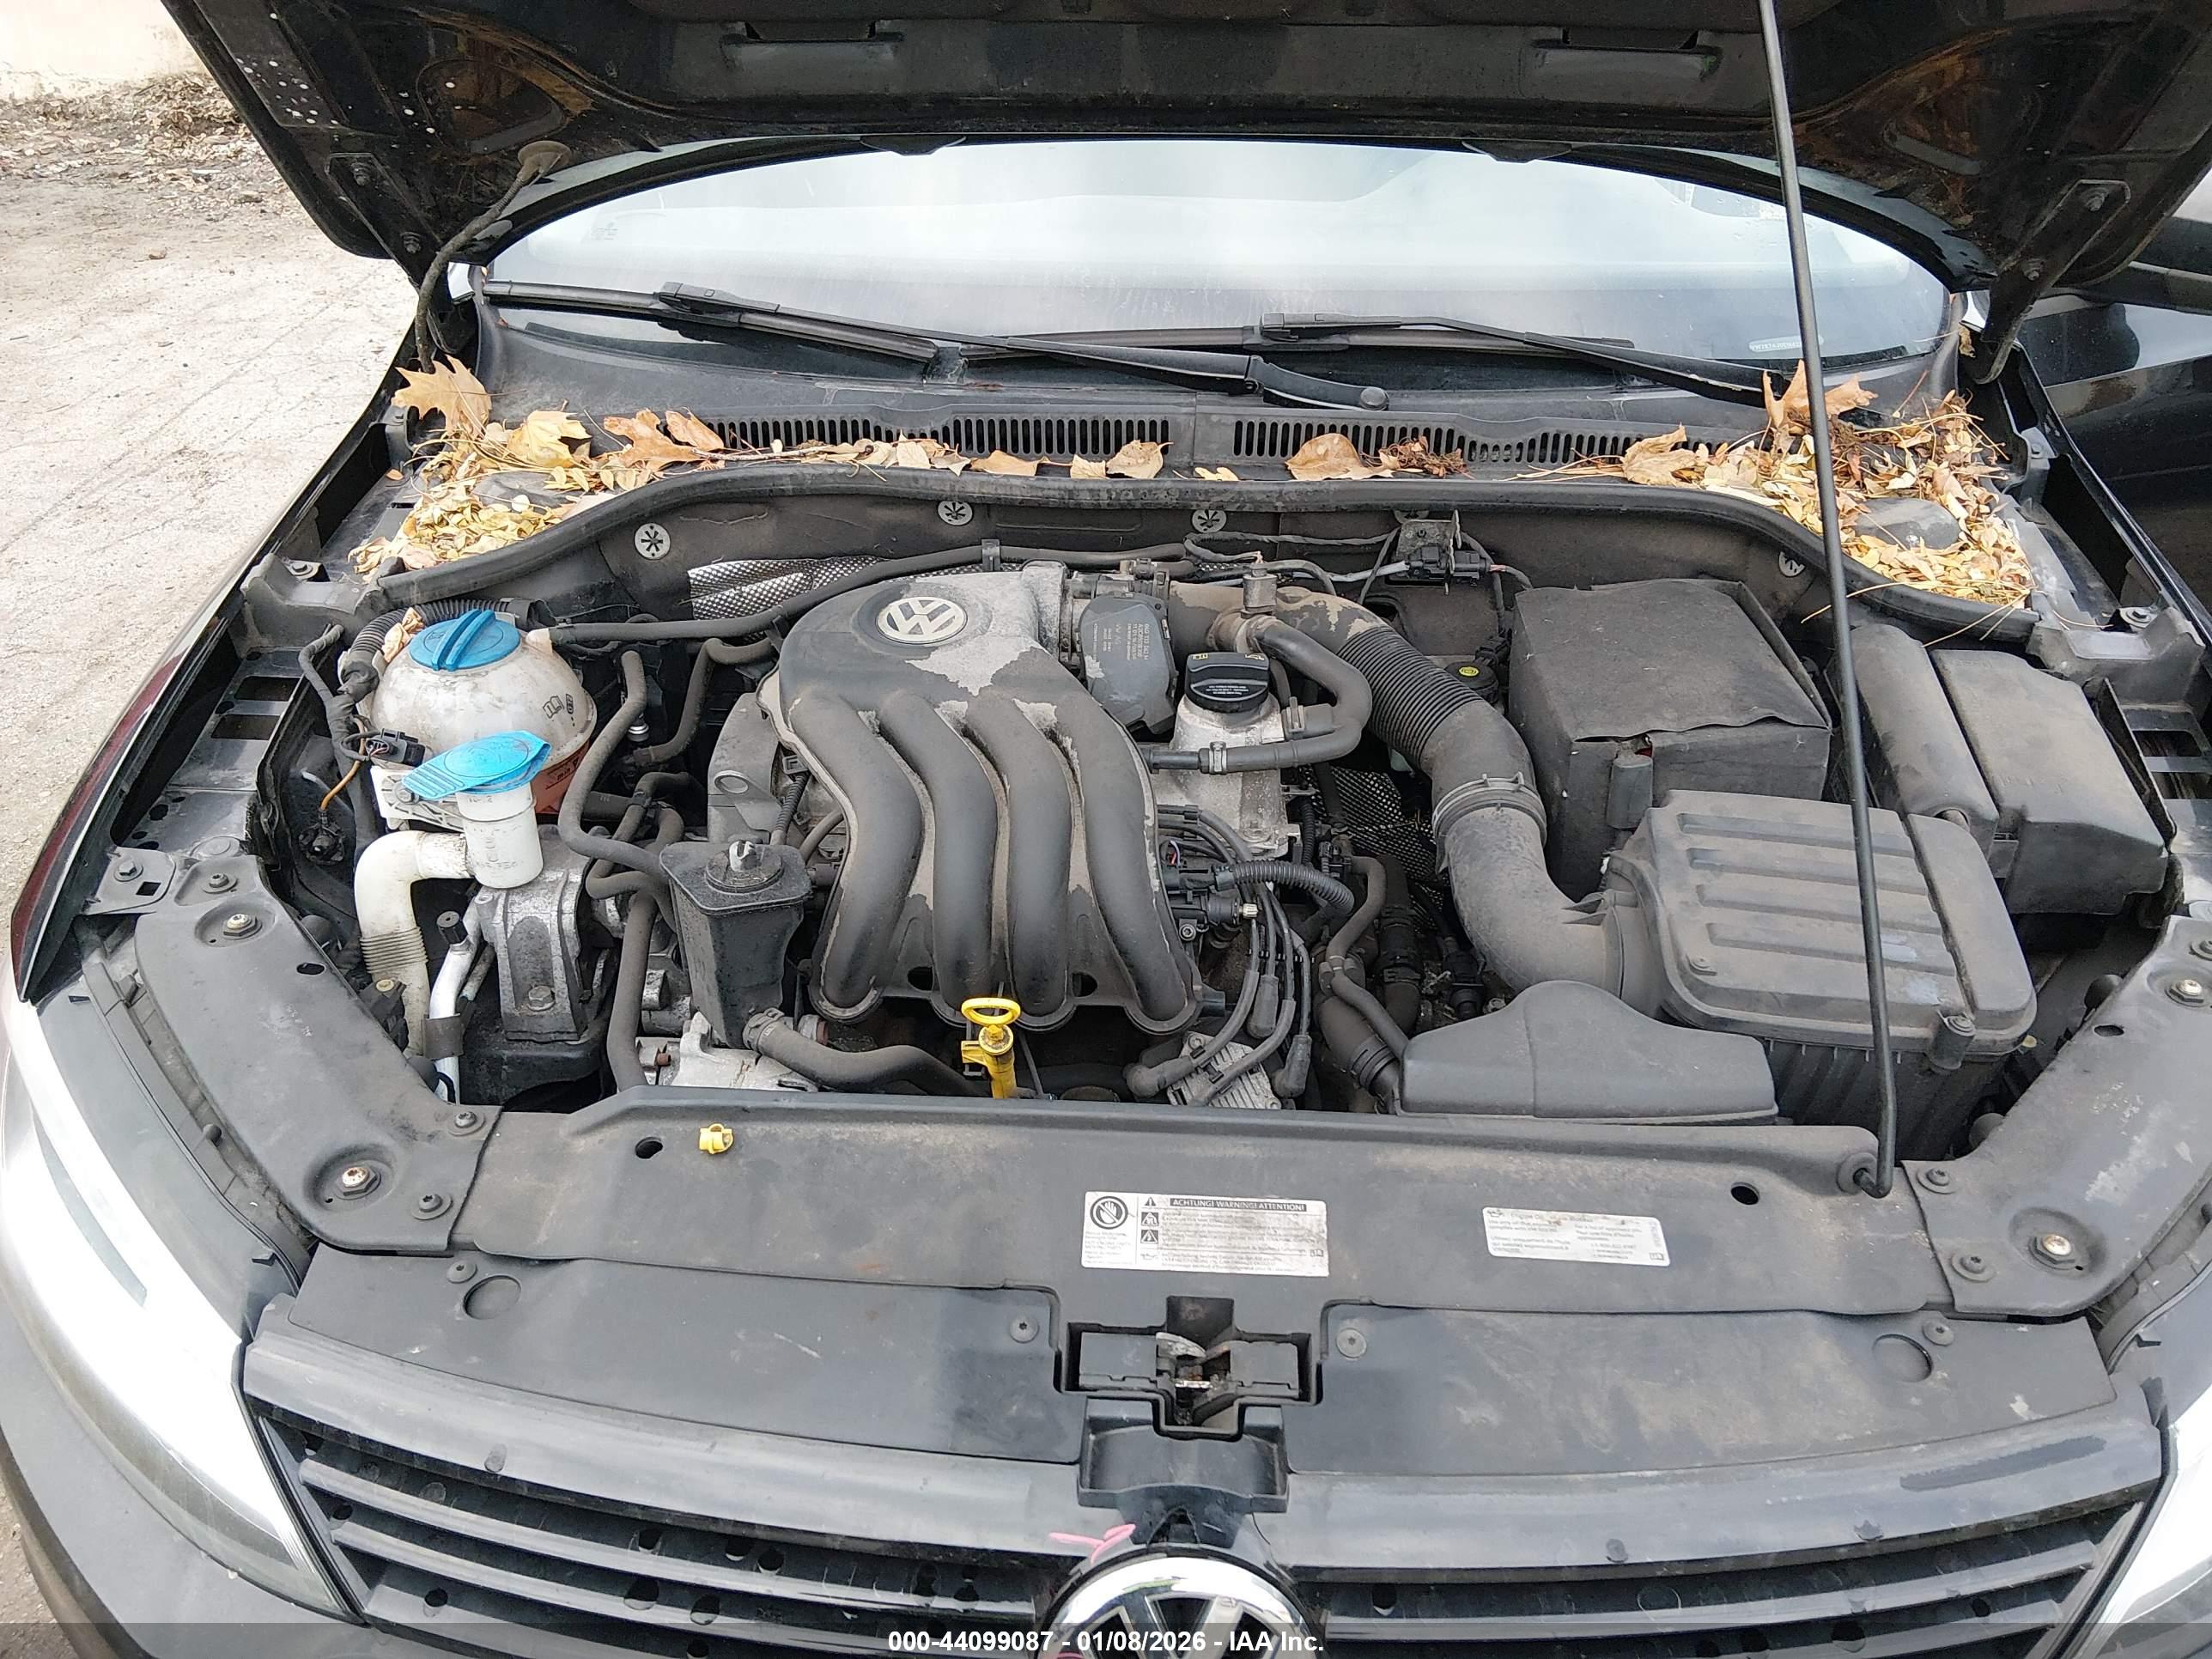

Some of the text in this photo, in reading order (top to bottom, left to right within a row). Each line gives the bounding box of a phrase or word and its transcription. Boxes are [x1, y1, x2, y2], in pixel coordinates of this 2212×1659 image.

[877, 596, 968, 644] VW
[1173, 1199, 1304, 1211] ACHTUNG! WARNING! ATTENTION!
